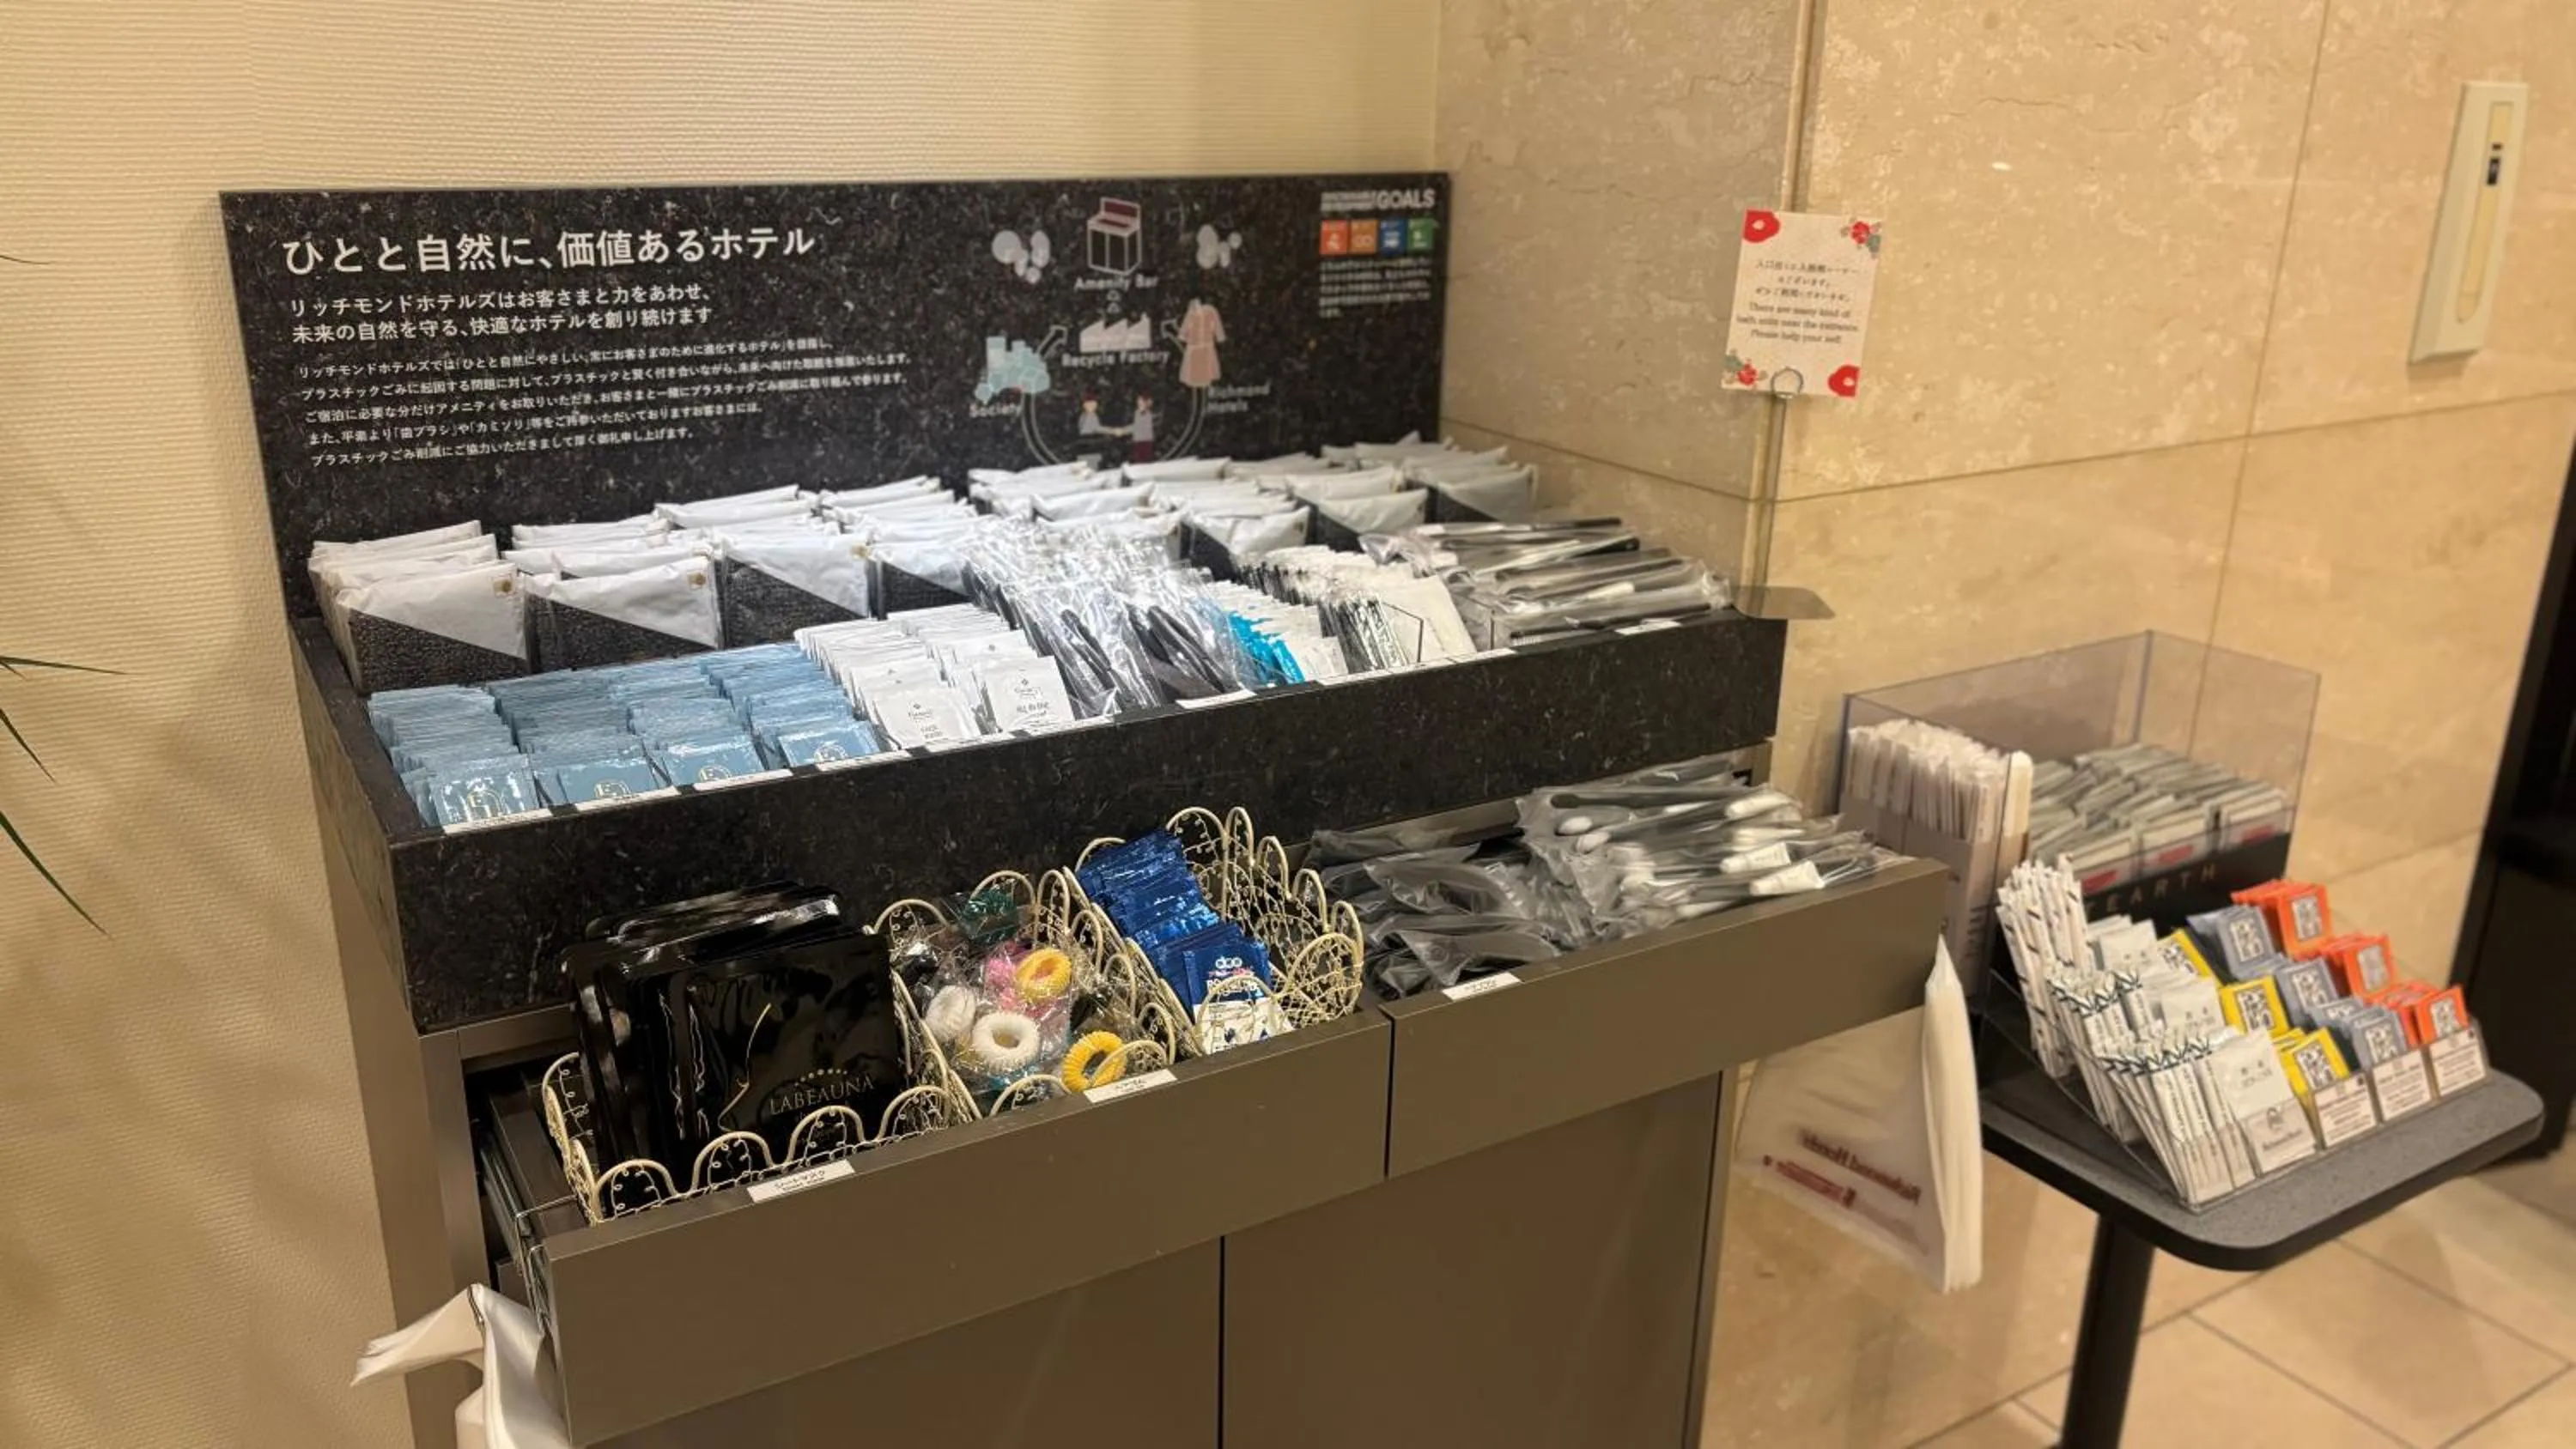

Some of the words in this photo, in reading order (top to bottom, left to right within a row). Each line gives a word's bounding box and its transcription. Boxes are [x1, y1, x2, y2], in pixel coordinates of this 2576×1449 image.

[1377, 188, 1436, 210] GOALS
[282, 227, 816, 276] ひとと自然に、価値あるホテル
[291, 283, 711, 317] リッチモンドホテルズはお客さまと力をあわせ、
[1073, 275, 1132, 293] Amenity
[1134, 273, 1158, 288] Bar
[292, 307, 712, 344] 未来の自然を守る、快適なホテルを創り続けます
[1062, 351, 1115, 369] Recycle
[1120, 349, 1170, 365] Factory
[769, 1073, 874, 1115] LABEAUNA
